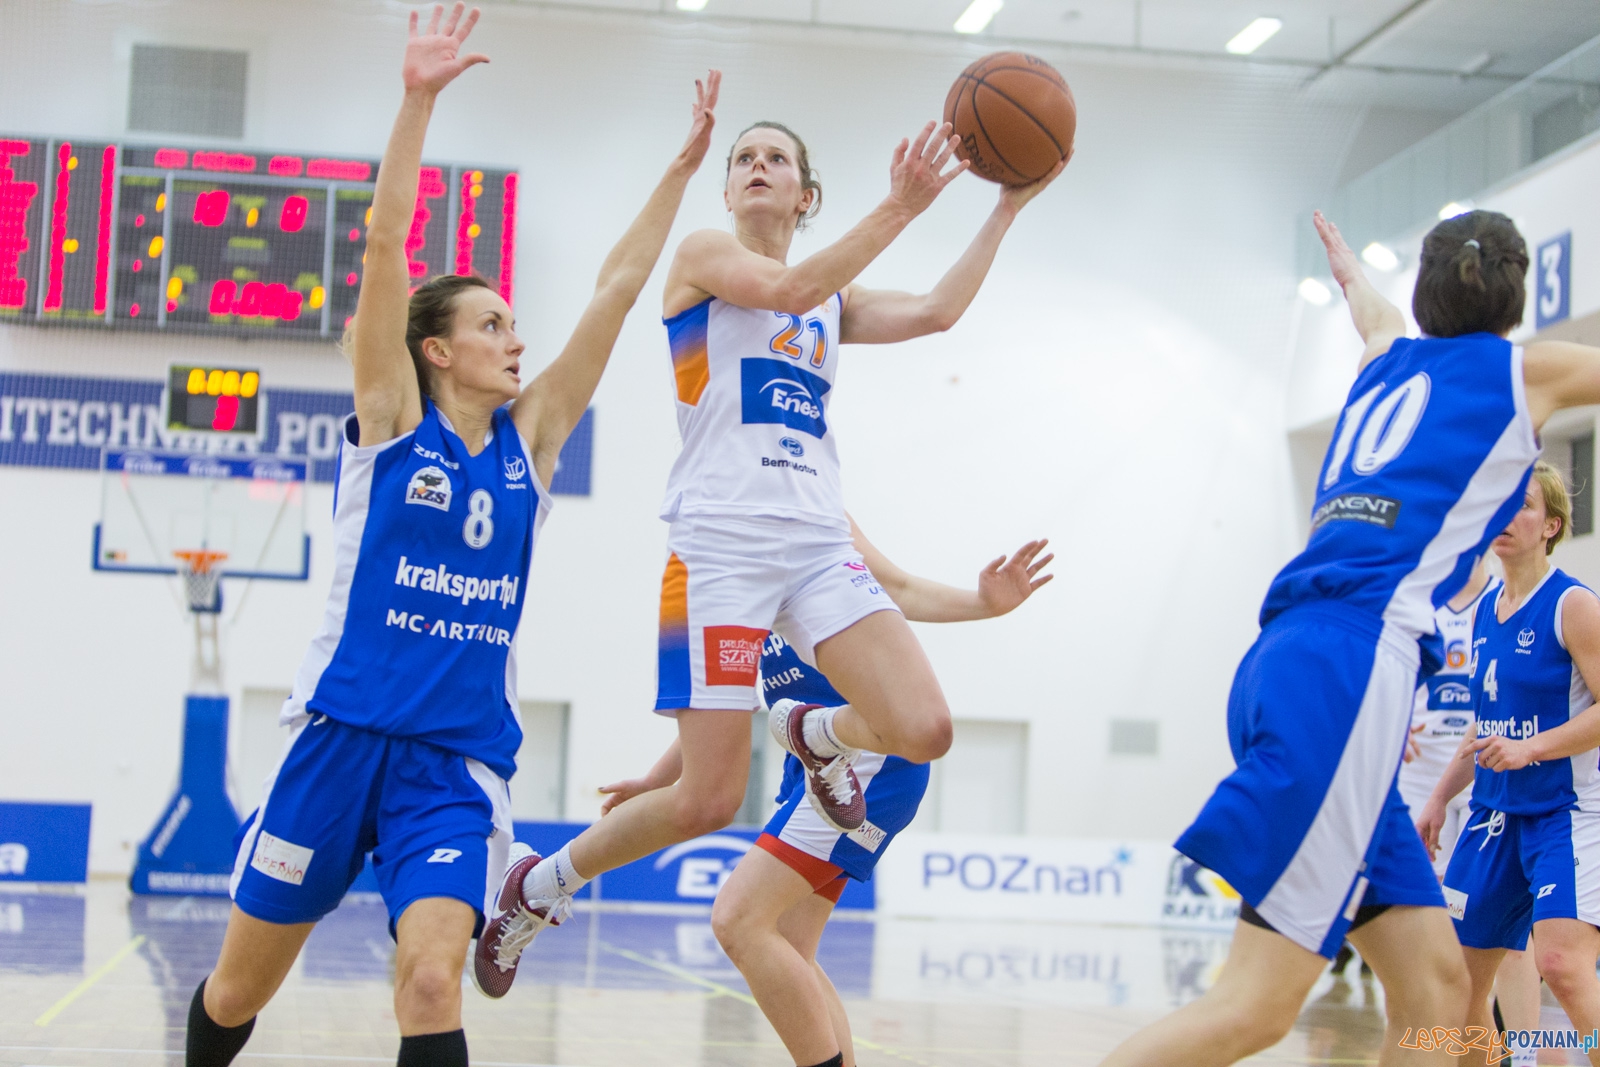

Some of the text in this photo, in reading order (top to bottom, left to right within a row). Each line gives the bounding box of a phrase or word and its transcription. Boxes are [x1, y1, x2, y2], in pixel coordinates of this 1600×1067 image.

[1541, 241, 1561, 318] 3
[769, 311, 828, 369] 21
[1323, 371, 1431, 491] 10
[463, 489, 494, 550] 8
[1446, 640, 1467, 669] 6
[1483, 659, 1499, 702] 4
